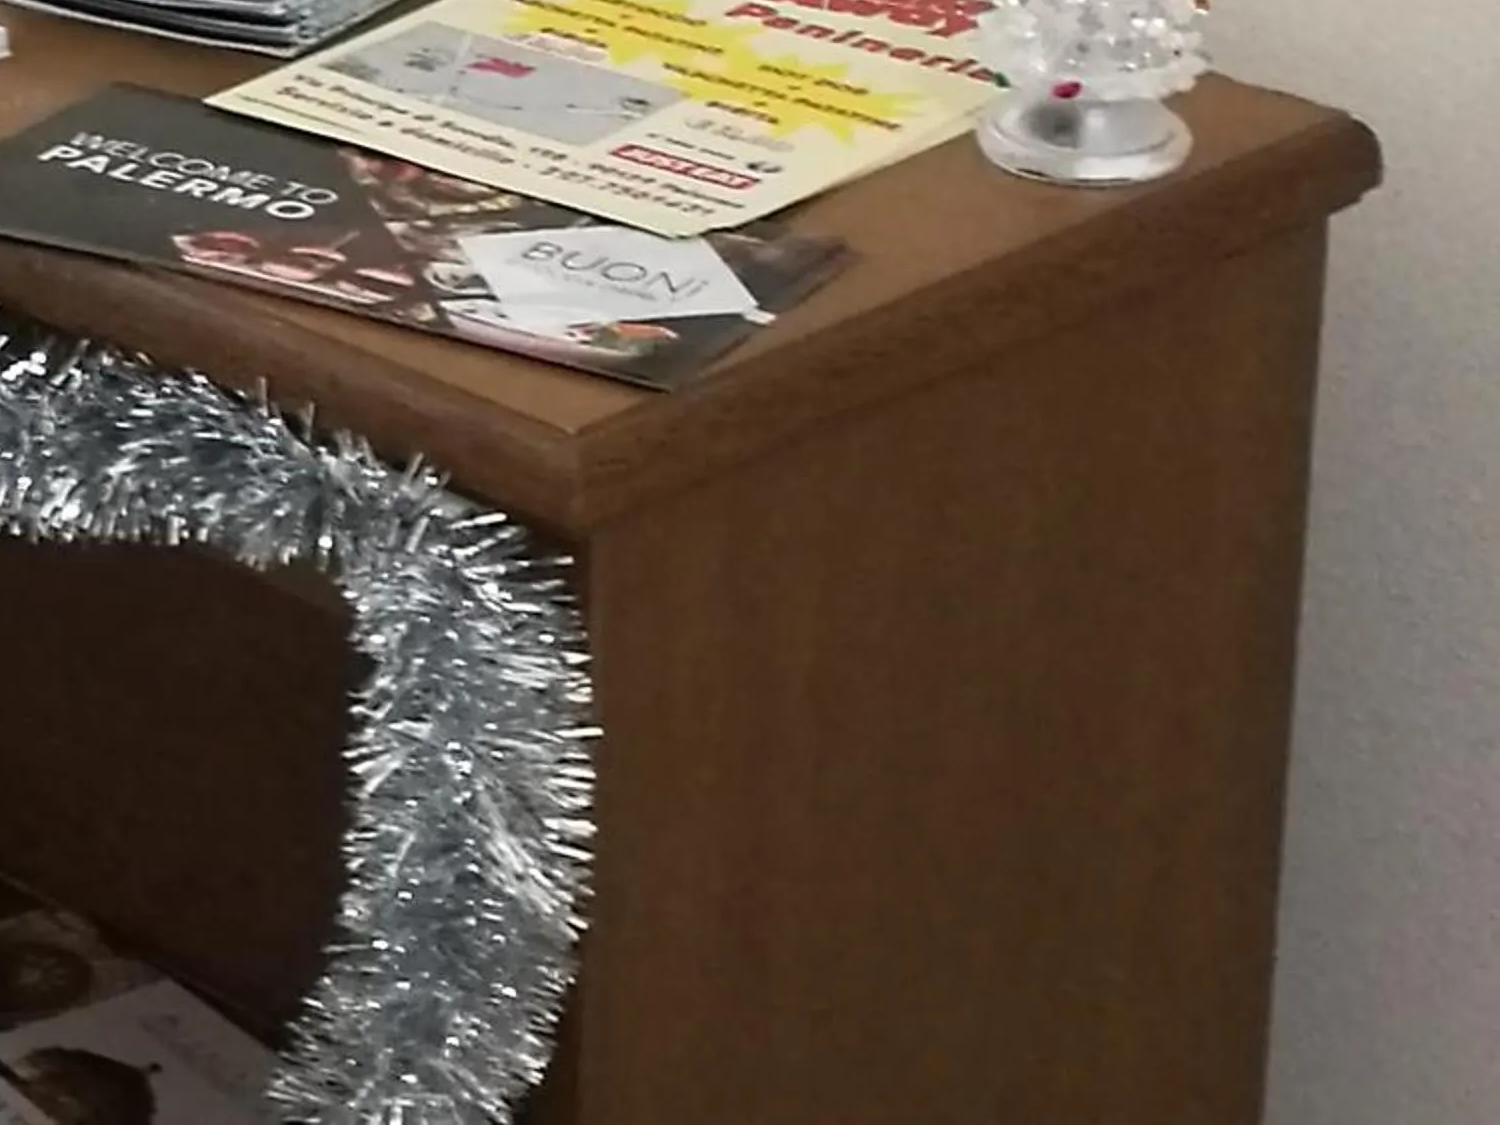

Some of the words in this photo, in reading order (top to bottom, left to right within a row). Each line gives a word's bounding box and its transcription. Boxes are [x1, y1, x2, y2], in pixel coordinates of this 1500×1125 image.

[36, 144, 316, 220] PALERMO
[69, 132, 277, 191] WELCOME
[281, 179, 340, 205] TO
